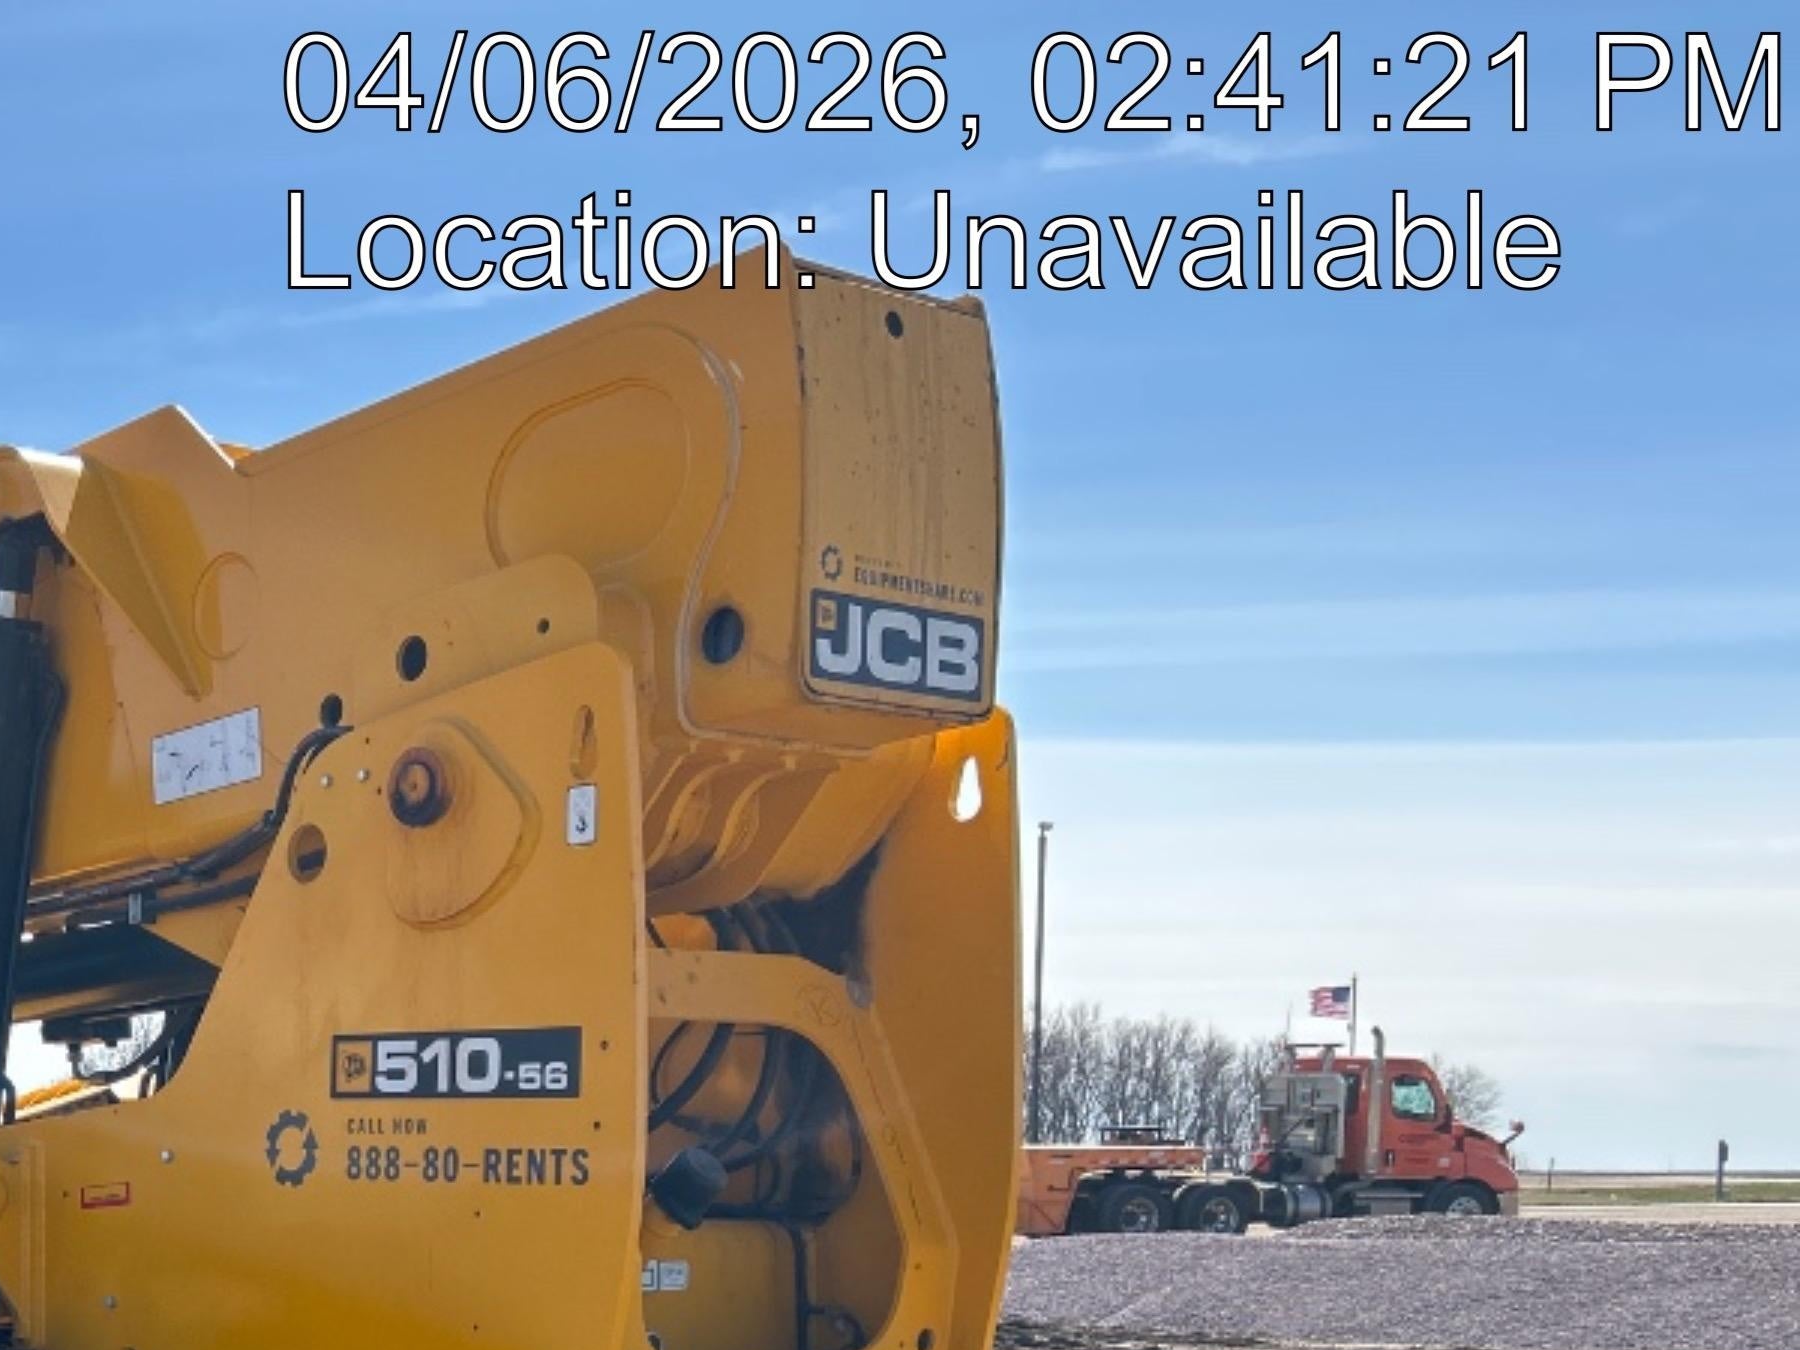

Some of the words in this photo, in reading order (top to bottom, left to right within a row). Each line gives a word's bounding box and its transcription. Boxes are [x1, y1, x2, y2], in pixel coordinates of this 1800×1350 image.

[814, 601, 980, 692] JCB
[346, 1117, 385, 1136] CALL
[392, 1118, 428, 1136] NOW
[346, 1145, 590, 1186] 888-80-RENTS
